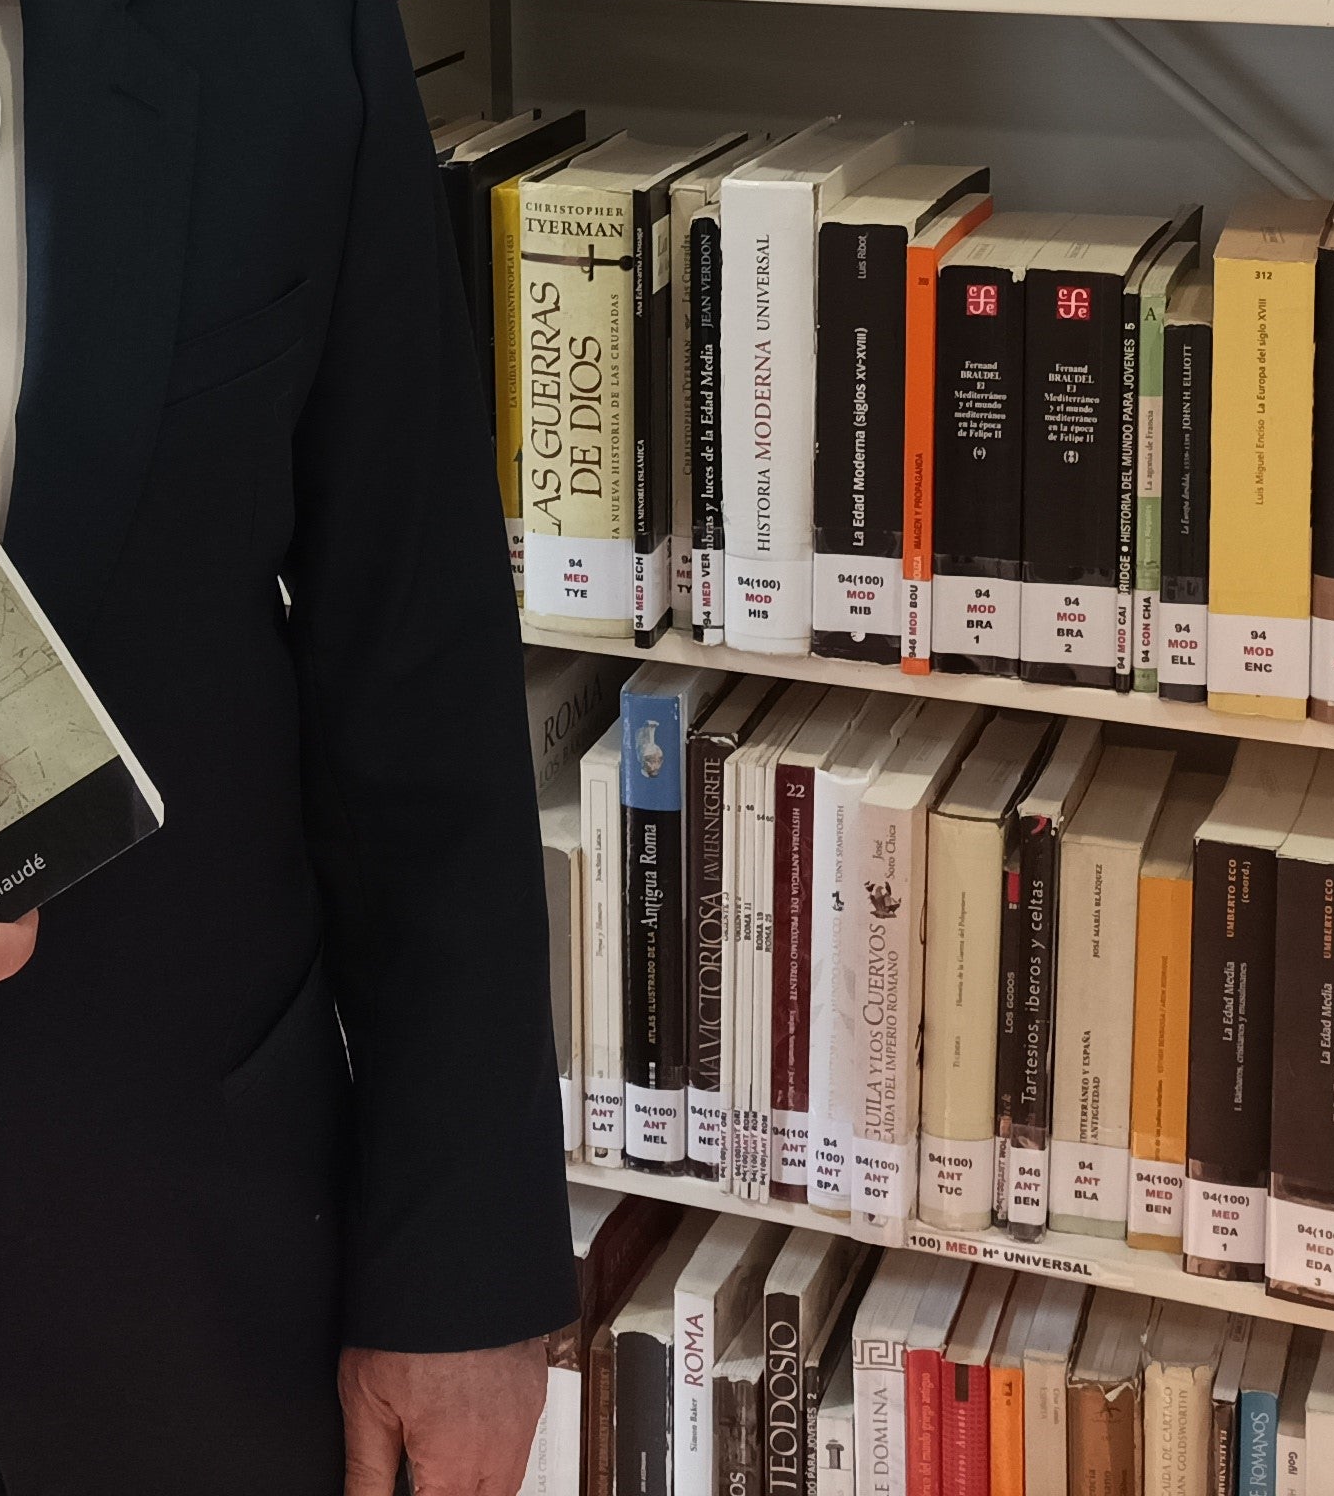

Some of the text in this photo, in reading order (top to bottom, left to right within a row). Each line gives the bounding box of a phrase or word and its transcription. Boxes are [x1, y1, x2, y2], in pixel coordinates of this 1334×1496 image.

[526, 218, 624, 238] TYERMAN
[569, 335, 602, 498] DE DIOS
[754, 234, 772, 552] HISTORIA MODERNA UNIVERSAL
[1031, 879, 1044, 932] celtas
[1031, 938, 1046, 949] y
[1025, 956, 1041, 1012] iberos
[685, 1312, 705, 1389] ROMA
[768, 1320, 798, 1492] TEODOSIO
